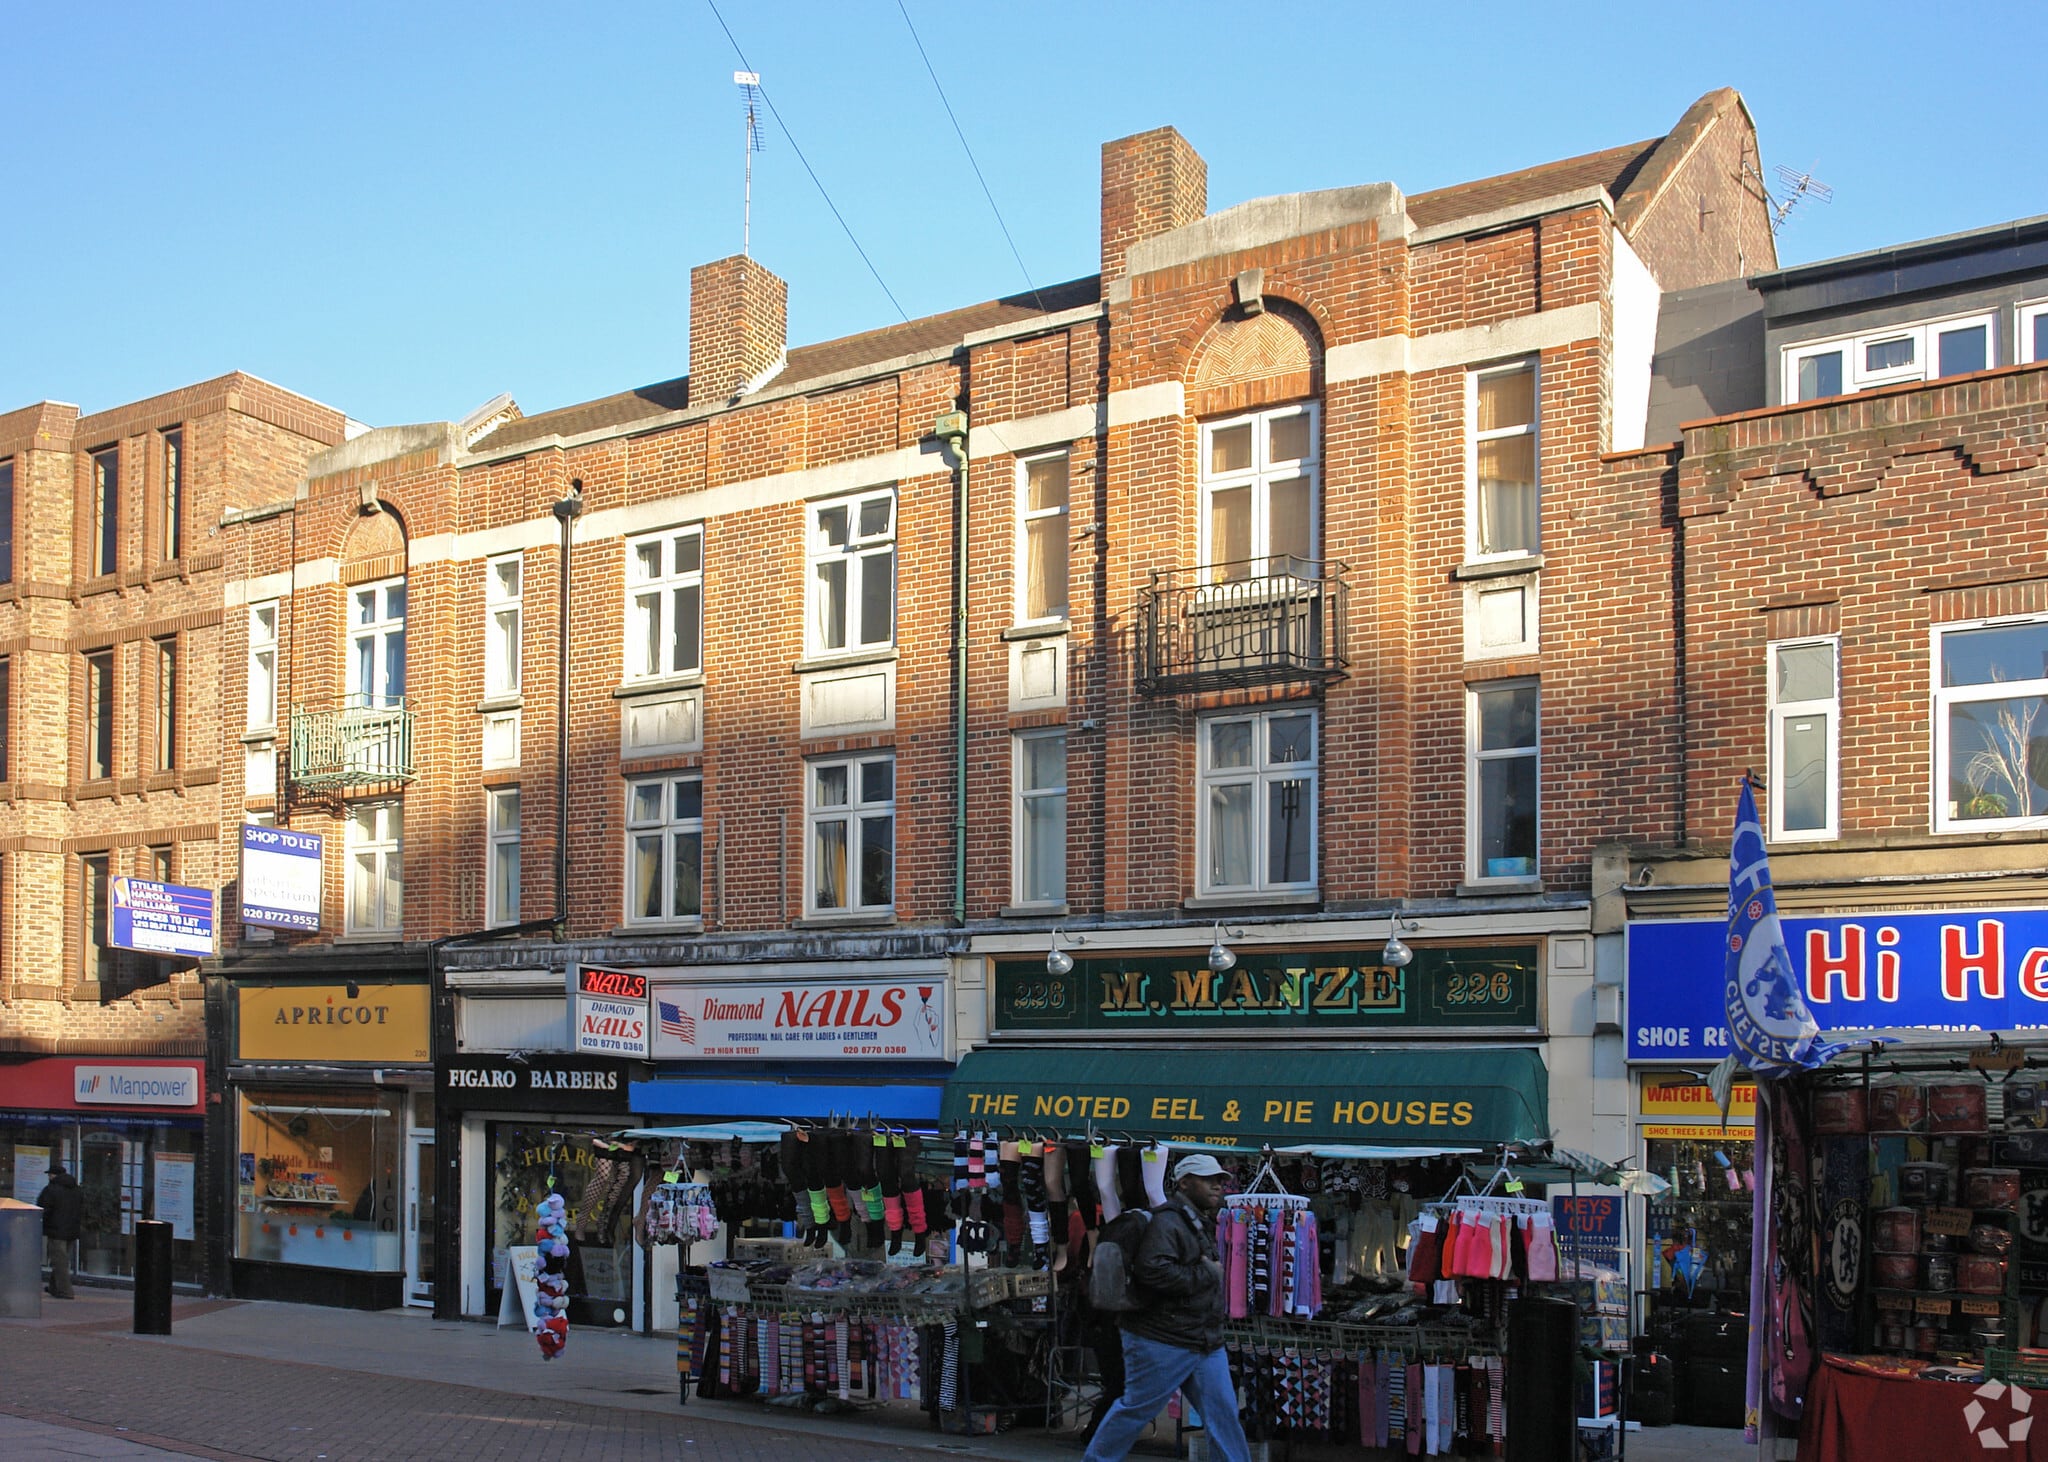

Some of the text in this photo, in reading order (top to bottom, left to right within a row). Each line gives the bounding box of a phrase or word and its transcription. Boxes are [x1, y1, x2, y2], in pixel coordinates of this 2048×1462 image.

[246, 829, 320, 851] SHOP TO LET
[131, 890, 173, 902] HAROLD
[131, 899, 180, 913] WILLIAMS
[169, 915, 182, 925] TO
[183, 916, 199, 928] LET
[243, 908, 319, 927] 020 8772 9552
[1805, 923, 1901, 1004] Hi
[585, 971, 646, 998] NAILS
[1446, 971, 1512, 1010] 226
[1013, 981, 1065, 1009] 226
[274, 1005, 390, 1025] APRICOT
[591, 1002, 635, 1016] DIAMOND
[703, 987, 907, 1028] Diamond NAILS
[582, 1014, 644, 1039] NAILS
[728, 1032, 768, 1041] PROFESSIONAL
[785, 1032, 800, 1041] CARE
[802, 1032, 814, 1041] FOR
[815, 1032, 836, 1041] LADIES
[843, 1031, 878, 1041] GENTLEMEN
[1637, 1026, 1690, 1047] SHOE
[582, 1037, 644, 1052] 020 8770 0360
[735, 1047, 760, 1055] STREET
[843, 1046, 859, 1054] 020
[110, 1074, 188, 1105] Manpower
[448, 1069, 618, 1090] FIGARO BARBERS
[1647, 1087, 1702, 1103] WATCH
[967, 1093, 1474, 1127] THE NOTED EEL & PIE HOUSES
[1648, 1127, 1669, 1136] SHOE
[1672, 1127, 1697, 1137] TREES
[1699, 1128, 1704, 1136] &
[1563, 1198, 1612, 1233] KEYS CUT
